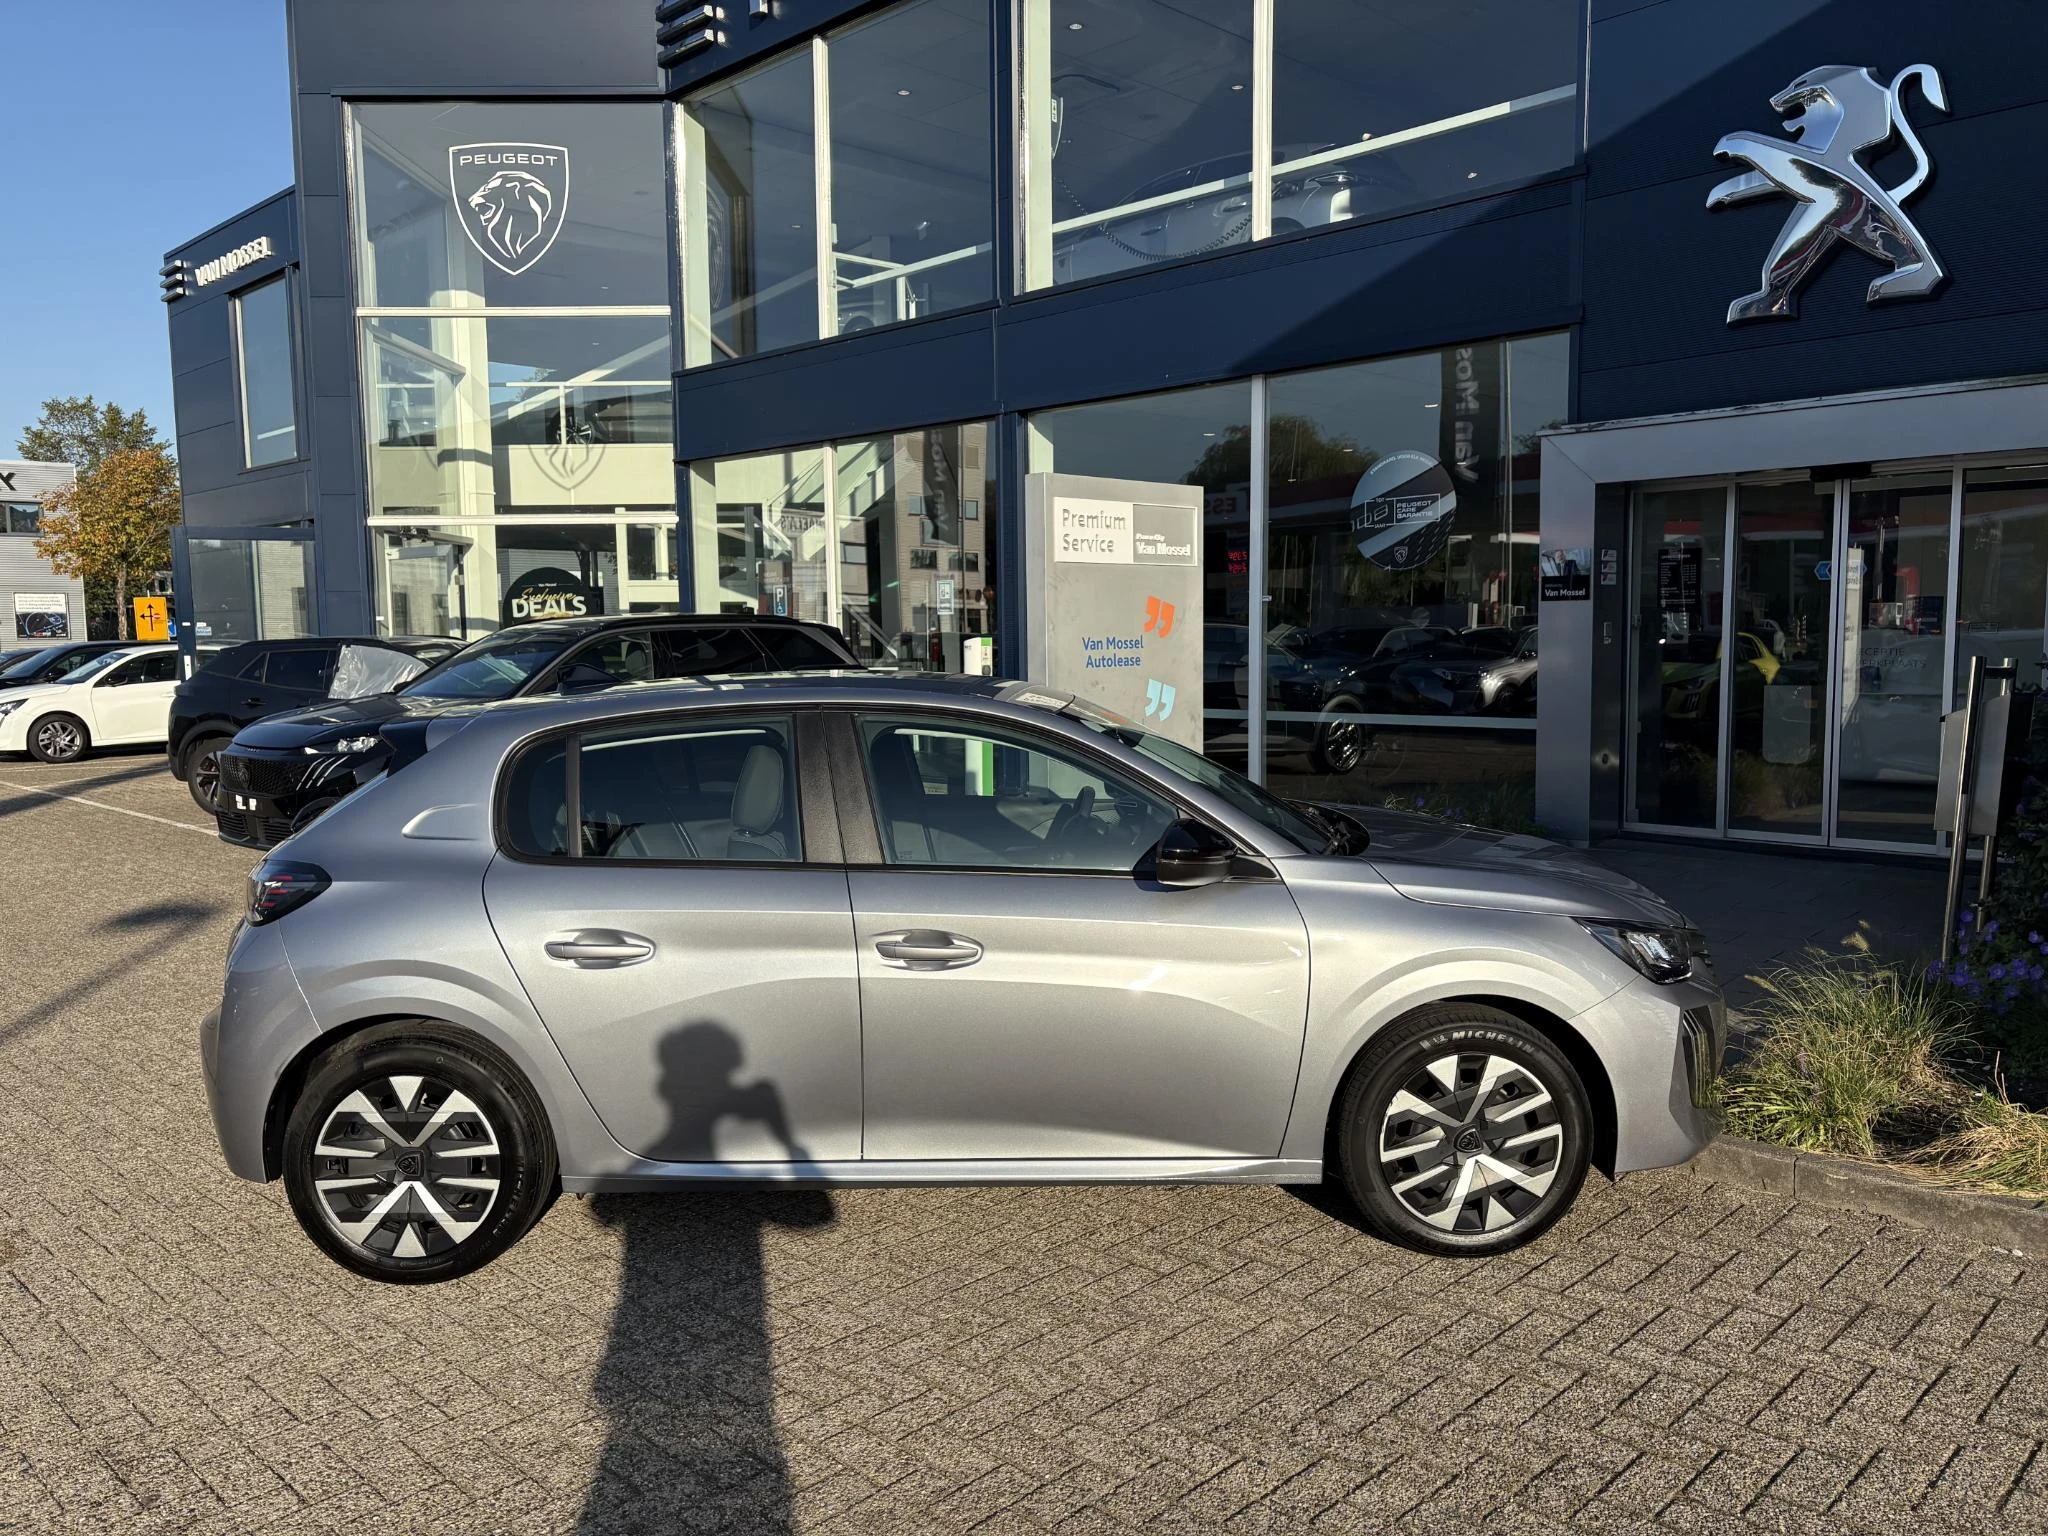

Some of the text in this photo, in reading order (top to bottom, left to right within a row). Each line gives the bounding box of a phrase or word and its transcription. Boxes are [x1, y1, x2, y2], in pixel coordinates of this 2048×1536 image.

[460, 153, 558, 167] PEUGEOT
[194, 236, 273, 287] VAN MOSSEL
[1396, 500, 1432, 509] PEUGEOT
[1062, 508, 1127, 531] Premium
[1062, 532, 1116, 553] Service
[1135, 541, 1191, 557] Van Mossel
[1544, 588, 1586, 597] Van Mossel
[511, 595, 587, 618] DEALS
[1082, 634, 1145, 651] Van Mossel
[1086, 653, 1142, 669] Autolease
[1452, 1030, 1536, 1054] MICHELIN
